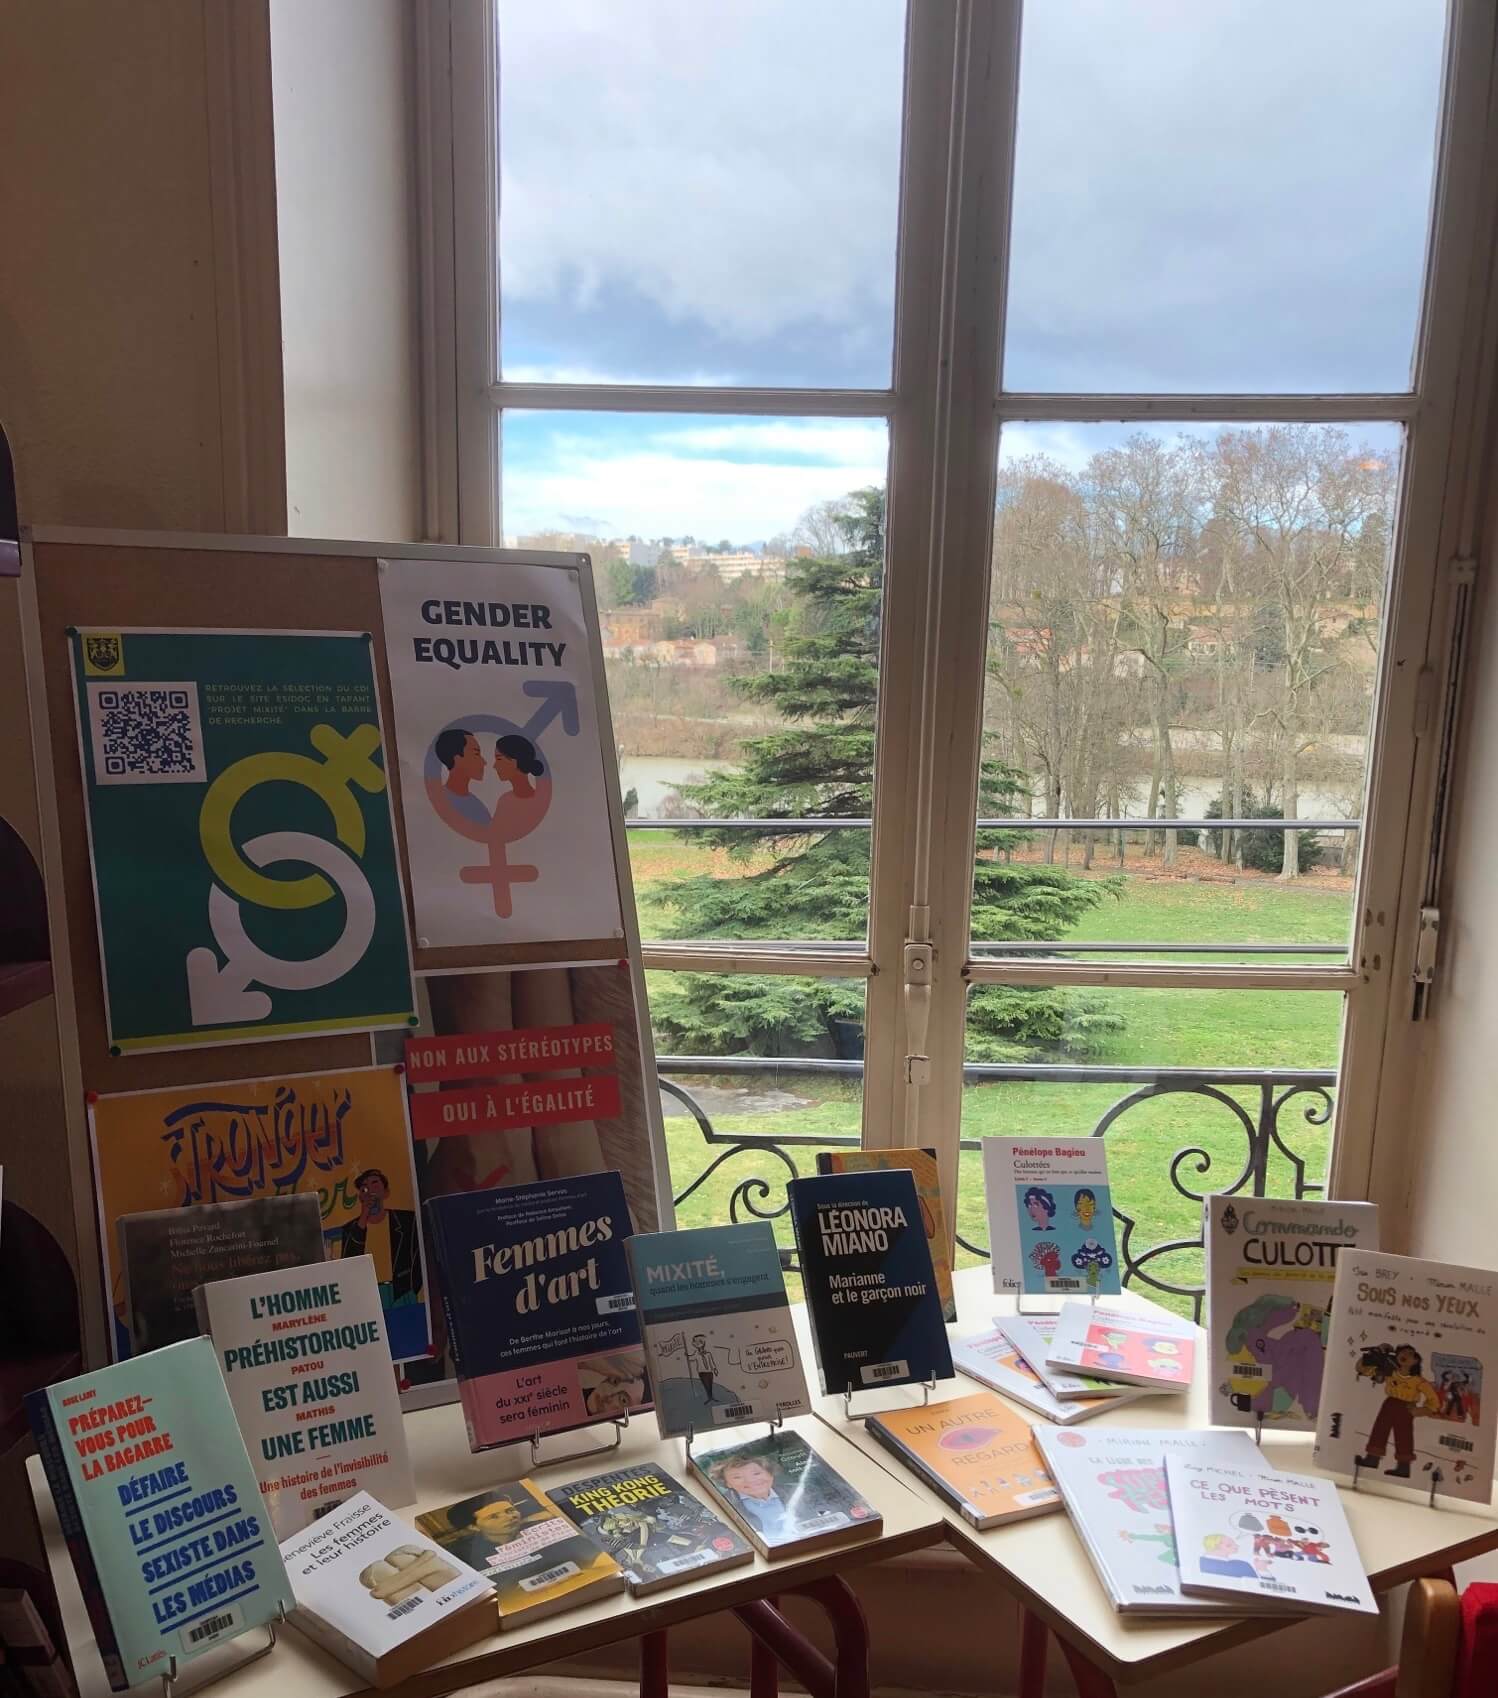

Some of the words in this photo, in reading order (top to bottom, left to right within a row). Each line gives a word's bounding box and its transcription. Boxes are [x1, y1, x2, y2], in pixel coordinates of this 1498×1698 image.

[420, 599, 553, 630] GENDER
[413, 637, 567, 670] EQUALITY
[206, 695, 225, 704] SUR
[232, 695, 243, 703] LE
[250, 695, 270, 703] SITE
[316, 695, 329, 703] EN
[267, 684, 279, 692] LA
[208, 717, 222, 725] DE
[224, 717, 282, 725] RECHERCHE
[410, 1051, 446, 1070] NON
[455, 1046, 489, 1065] AUX
[497, 1034, 613, 1061] STÉRÉOTYPES
[443, 1102, 476, 1122] OUI
[486, 1095, 498, 1118] À
[506, 1085, 595, 1116] L'ÉGALITÉ
[818, 1206, 908, 1234] LÉONORA
[1242, 1210, 1359, 1239] Commando
[472, 1216, 614, 1285] Femmes
[822, 1230, 889, 1257] MIANO
[1243, 1238, 1356, 1267] CULOTT
[515, 1257, 601, 1315] d'art
[829, 1272, 886, 1289] Marianne
[1375, 1268, 1400, 1281] BREY
[250, 1283, 342, 1320] L'HOMME
[831, 1291, 844, 1305] et
[846, 1289, 858, 1303] le
[860, 1286, 902, 1305] garçon
[903, 1281, 927, 1298] noir
[1436, 1294, 1480, 1318] YEUX
[224, 1321, 380, 1373] PRÉHISTORIQUE
[509, 1335, 520, 1346] De
[520, 1329, 544, 1343] Berthe
[544, 1324, 571, 1338] Morisot
[577, 1323, 588, 1332] nos
[513, 1340, 542, 1354] femmes
[542, 1338, 554, 1350] qui
[554, 1335, 568, 1346] font
[598, 1330, 607, 1338] de
[291, 1361, 325, 1376] PATOU
[516, 1375, 542, 1389] L'art
[262, 1384, 299, 1413] EST
[302, 1371, 361, 1404] AUSSI
[496, 1396, 512, 1409] du
[536, 1385, 568, 1400] siècle
[296, 1405, 336, 1422] MATHIS
[499, 1411, 527, 1425] sera
[528, 1400, 570, 1418] féminin
[905, 1422, 936, 1436] UN
[938, 1408, 1001, 1430] AUTRE
[75, 1430, 116, 1457] VOUS
[115, 1415, 157, 1443] POUR
[261, 1431, 305, 1461] UNE
[308, 1414, 377, 1451] FEMME
[82, 1460, 105, 1481] LA
[104, 1432, 174, 1473] BAGARRE
[951, 1441, 1031, 1466] REGARD
[117, 1460, 190, 1506] DÉFAIRE
[260, 1479, 281, 1494] Une
[281, 1471, 319, 1489] histoire
[320, 1466, 333, 1479] de
[333, 1452, 390, 1475] l'invisibilité
[562, 1466, 653, 1495] DESPENTES
[300, 1487, 319, 1501] des
[319, 1477, 358, 1497] femmes
[568, 1488, 612, 1507] KING
[611, 1474, 660, 1493] KONG
[1190, 1479, 1210, 1490] CE
[1218, 1482, 1252, 1496] QUE
[1257, 1487, 1321, 1507] PÈSENT
[1201, 1490, 1226, 1502] LES
[1244, 1498, 1295, 1512] MOTS
[129, 1518, 154, 1545] LE
[153, 1484, 239, 1535] DISCOURS
[332, 1503, 371, 1534] Fraisse
[142, 1545, 215, 1583] SEXISTE
[213, 1516, 261, 1552] DANS
[302, 1563, 318, 1576] et
[319, 1548, 344, 1567] leur
[343, 1518, 392, 1551] histoire
[310, 1543, 335, 1560] Les
[333, 1512, 385, 1546] femmes
[152, 1591, 188, 1625] LES
[186, 1560, 256, 1607] MÉDIAS
